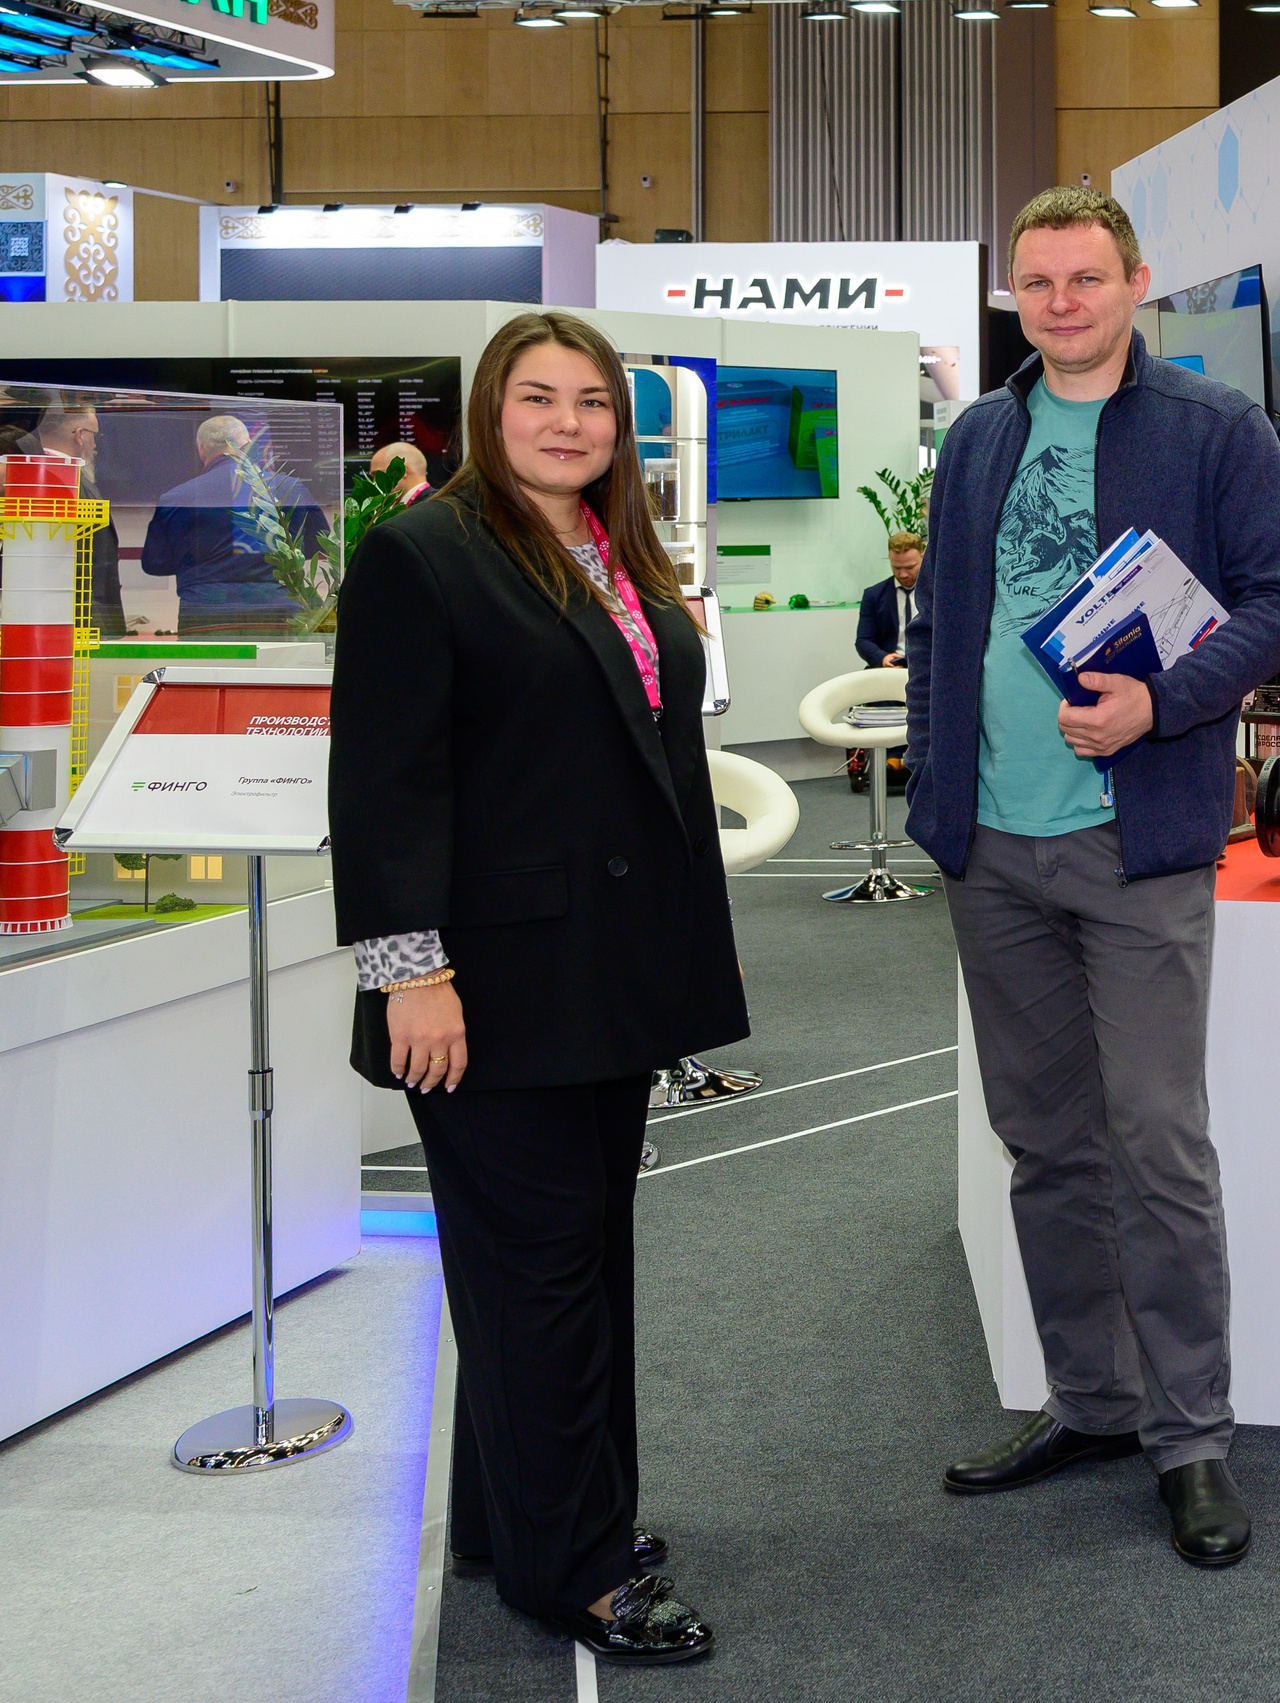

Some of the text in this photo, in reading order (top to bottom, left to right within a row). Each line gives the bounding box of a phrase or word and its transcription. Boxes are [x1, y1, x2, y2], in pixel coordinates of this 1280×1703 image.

[694, 278, 877, 309] НАМИ
[1000, 572, 1040, 597] NTURE
[1075, 590, 1114, 625] VOLTE
[246, 727, 328, 736] ТЕХНОЛОГИИ
[147, 781, 208, 792] ФИНГО
[238, 776, 313, 785] Группа «ФИНГО»
